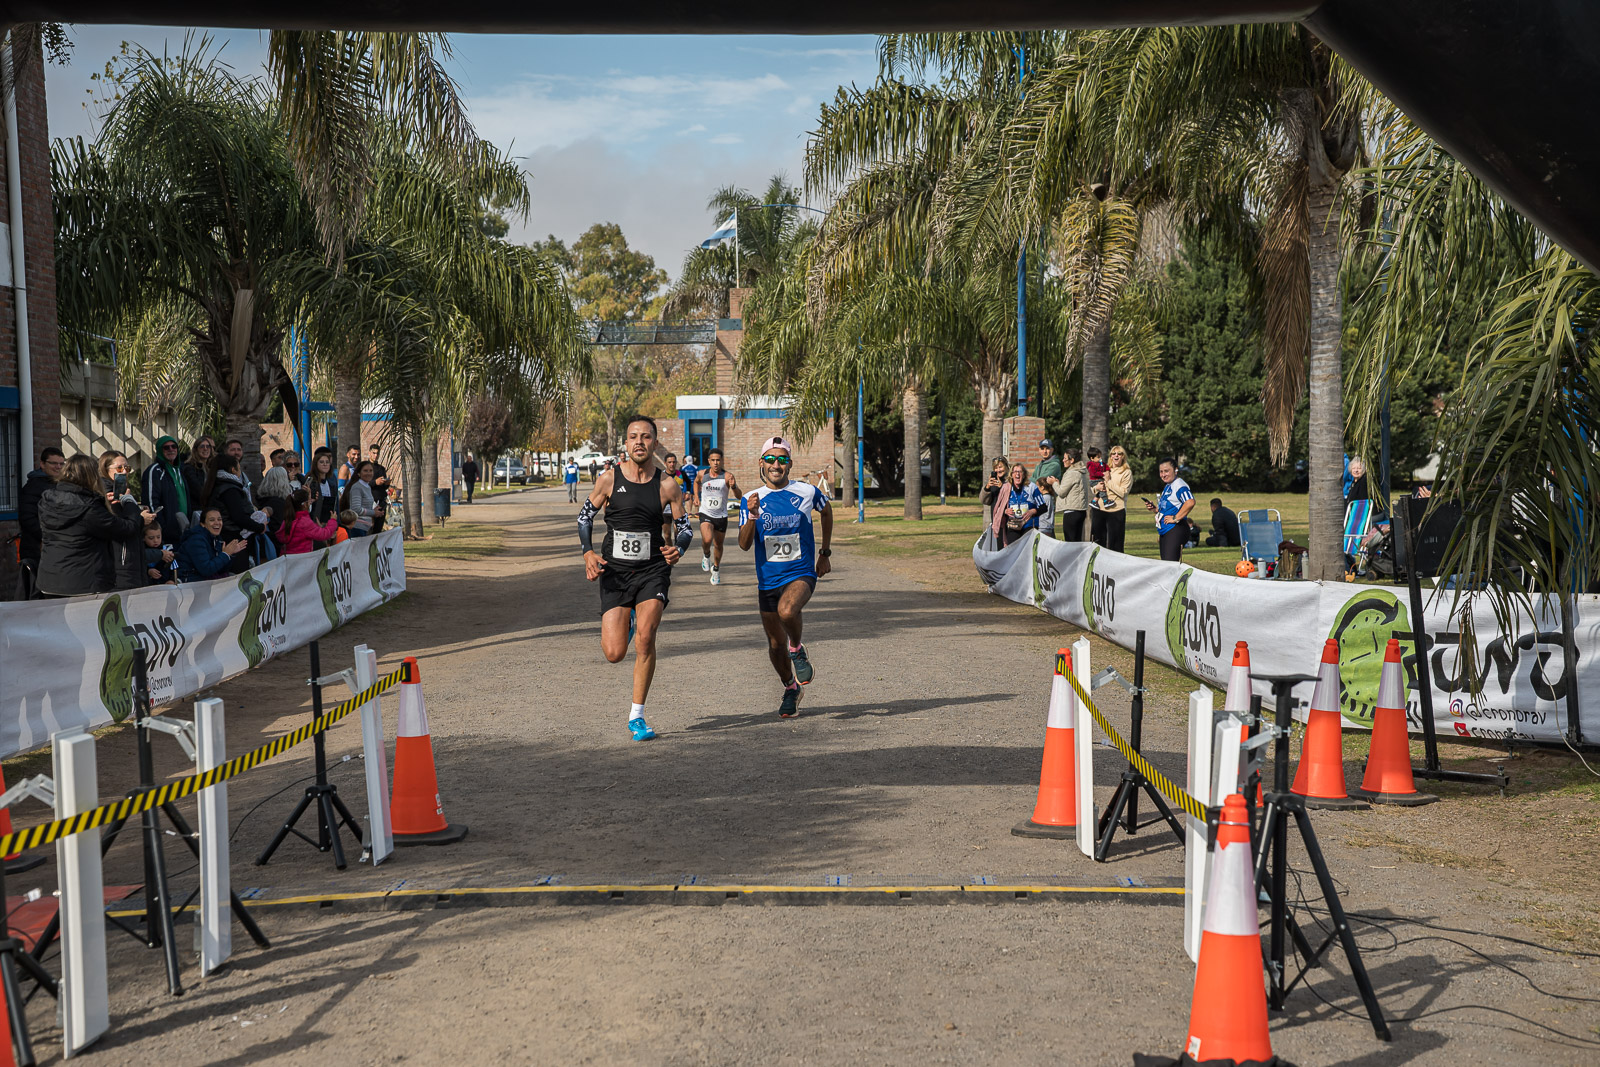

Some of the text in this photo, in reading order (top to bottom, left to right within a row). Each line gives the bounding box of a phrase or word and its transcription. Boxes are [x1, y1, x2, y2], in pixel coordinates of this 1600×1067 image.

[762, 512, 773, 531] 3
[621, 539, 641, 553] 88
[773, 542, 792, 555] 20
[1465, 703, 1547, 725] @cronorav
